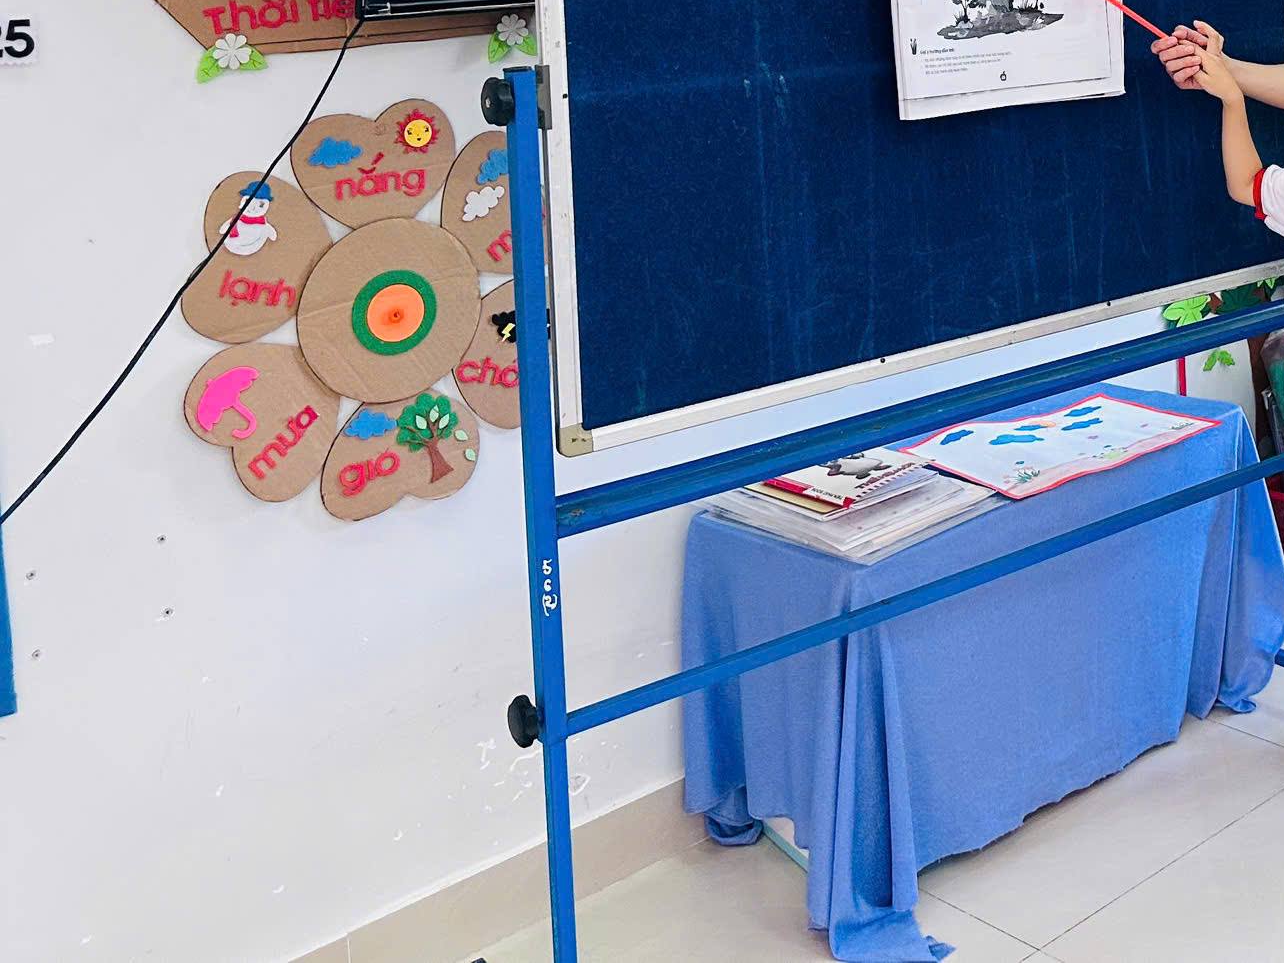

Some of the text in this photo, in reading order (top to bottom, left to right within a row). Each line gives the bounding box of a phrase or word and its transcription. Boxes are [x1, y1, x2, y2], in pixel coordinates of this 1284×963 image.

[0, 19, 35, 58] 5
[335, 153, 427, 201] nắng
[218, 270, 297, 307] lạnh
